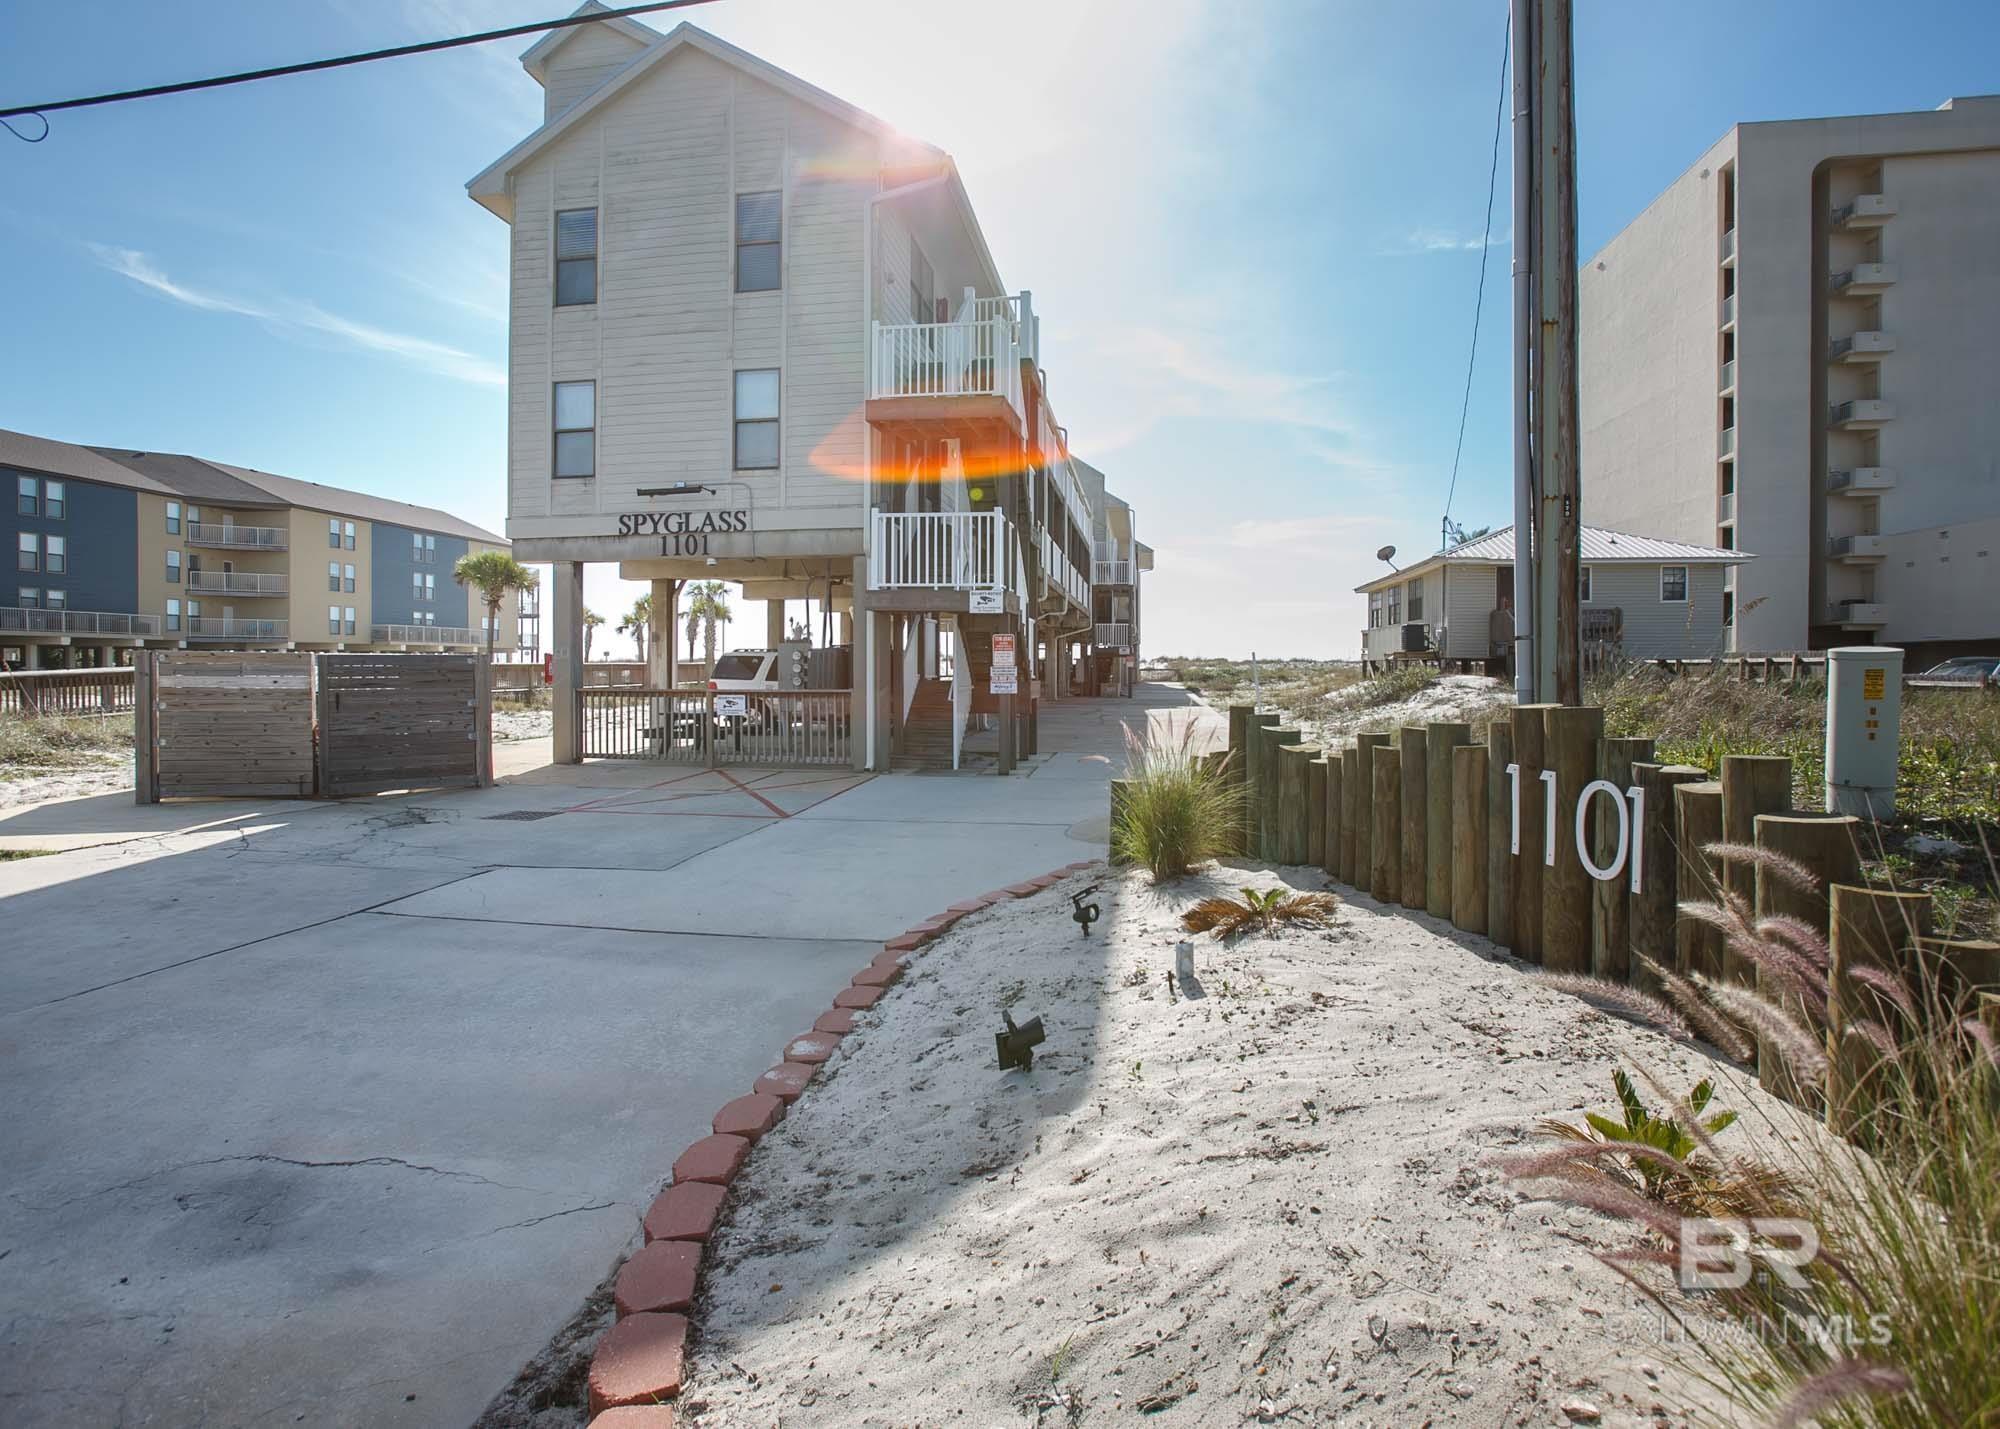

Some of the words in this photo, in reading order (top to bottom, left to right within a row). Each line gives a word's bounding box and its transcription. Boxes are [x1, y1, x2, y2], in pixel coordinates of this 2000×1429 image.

[618, 510, 748, 537] SPYGLASS
[660, 534, 711, 556] 1101
[1505, 763, 1645, 895] 1101
